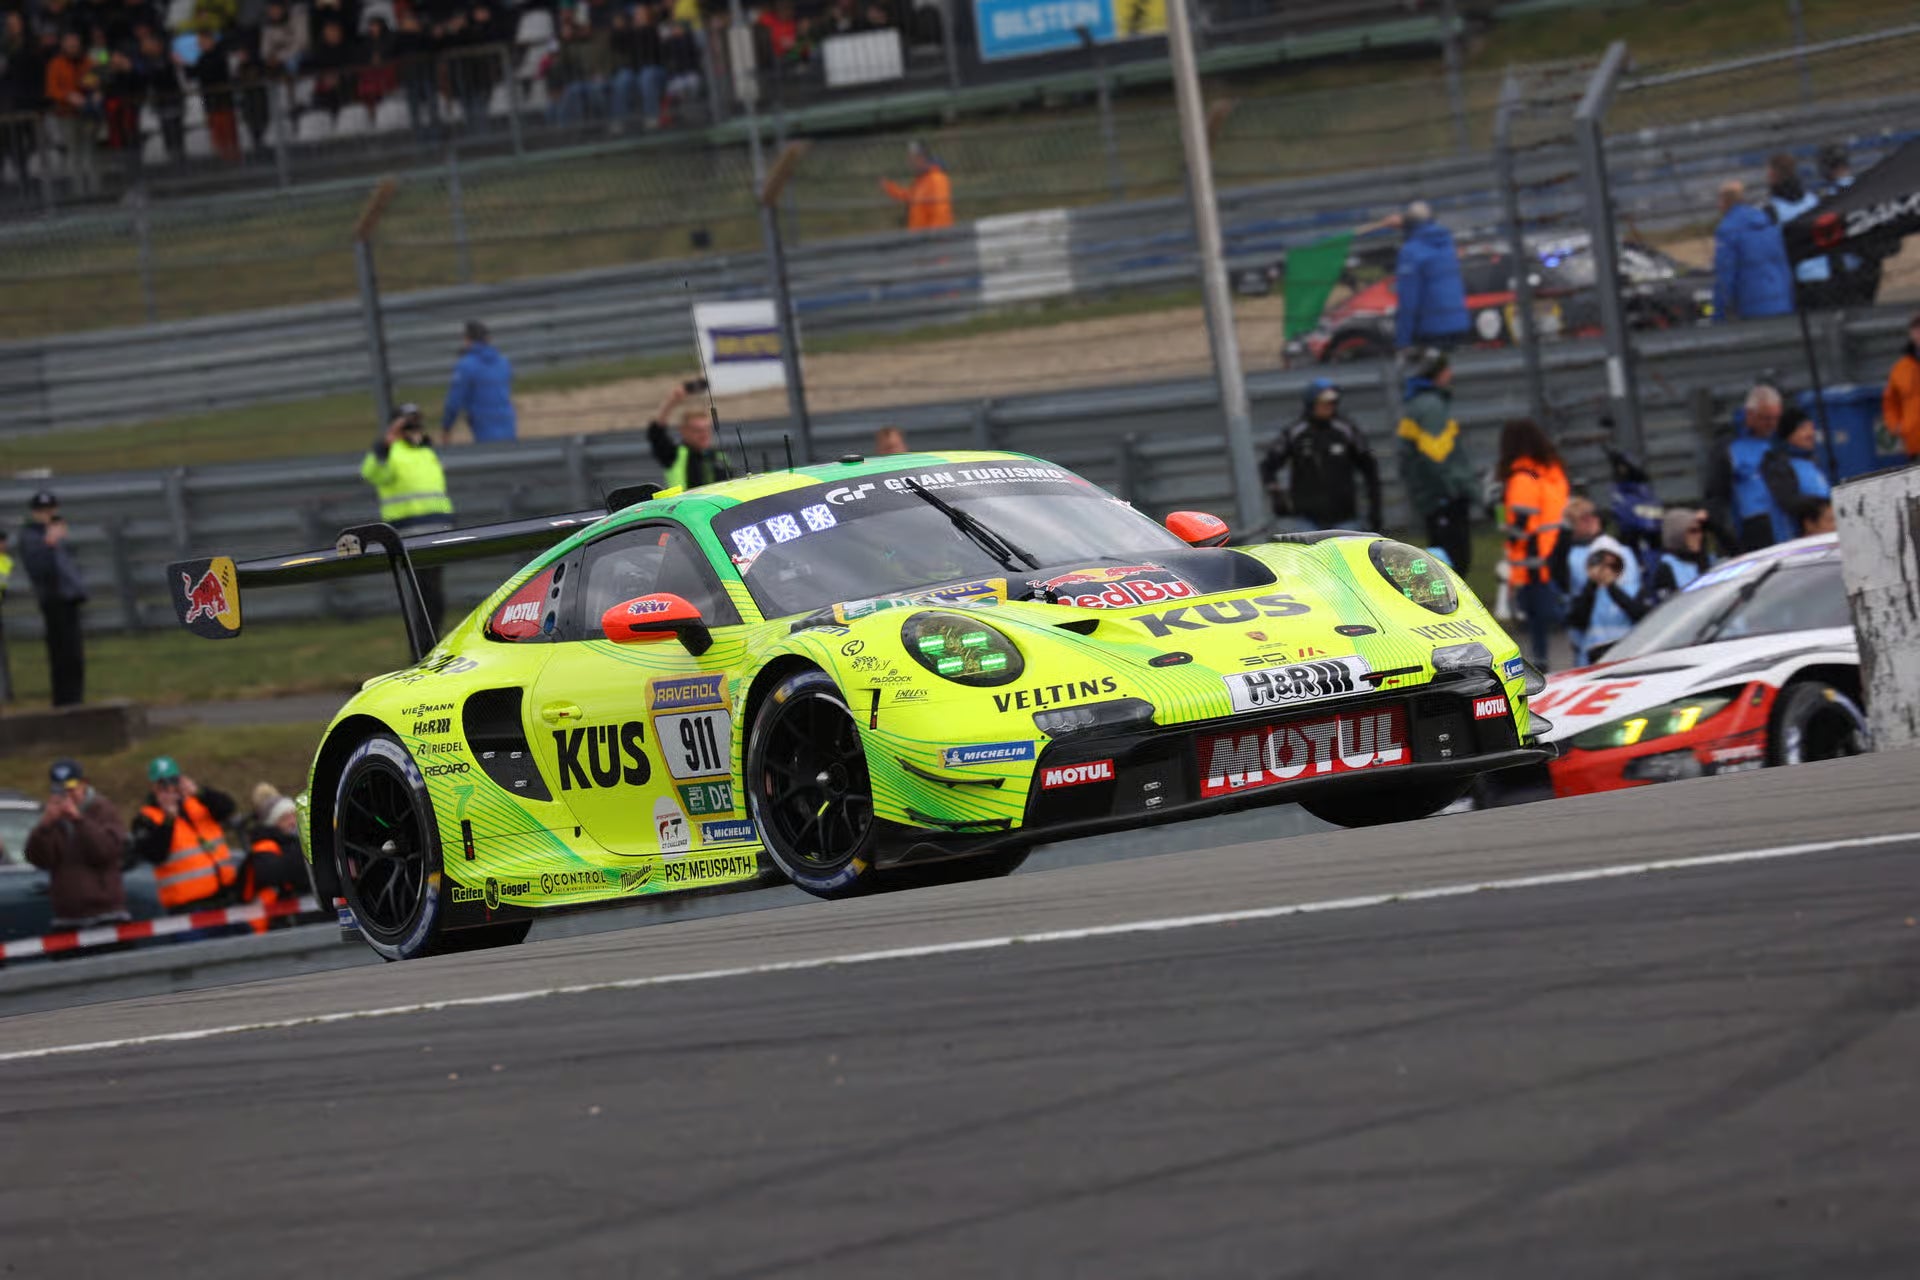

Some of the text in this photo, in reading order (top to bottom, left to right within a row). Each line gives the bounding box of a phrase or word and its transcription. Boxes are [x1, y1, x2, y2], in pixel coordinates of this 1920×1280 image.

[884, 466, 1064, 491] GRAN TURISMO
[501, 601, 540, 625] MOTUL
[1409, 619, 1487, 640] VELTINS
[869, 676, 912, 684] PADDOCK
[656, 683, 717, 702] RAVENOL
[895, 689, 929, 698] ENDLESS
[993, 676, 1118, 713] VELTINS
[401, 703, 455, 718] VIESSMANN
[1476, 700, 1507, 716] MOTUL
[431, 742, 463, 754] RIEDEL
[679, 716, 721, 771] 911
[1207, 713, 1403, 788] MOTUL
[552, 721, 651, 791] KÜS
[963, 747, 1026, 761] MICHELIN
[424, 763, 471, 777] RECARO
[1046, 768, 1112, 786] MOTUL
[714, 826, 751, 838] MICHELIN
[665, 856, 751, 882] PSZ MEUSPATH
[553, 871, 606, 886] CONTROL
[453, 888, 484, 901] Reifen
